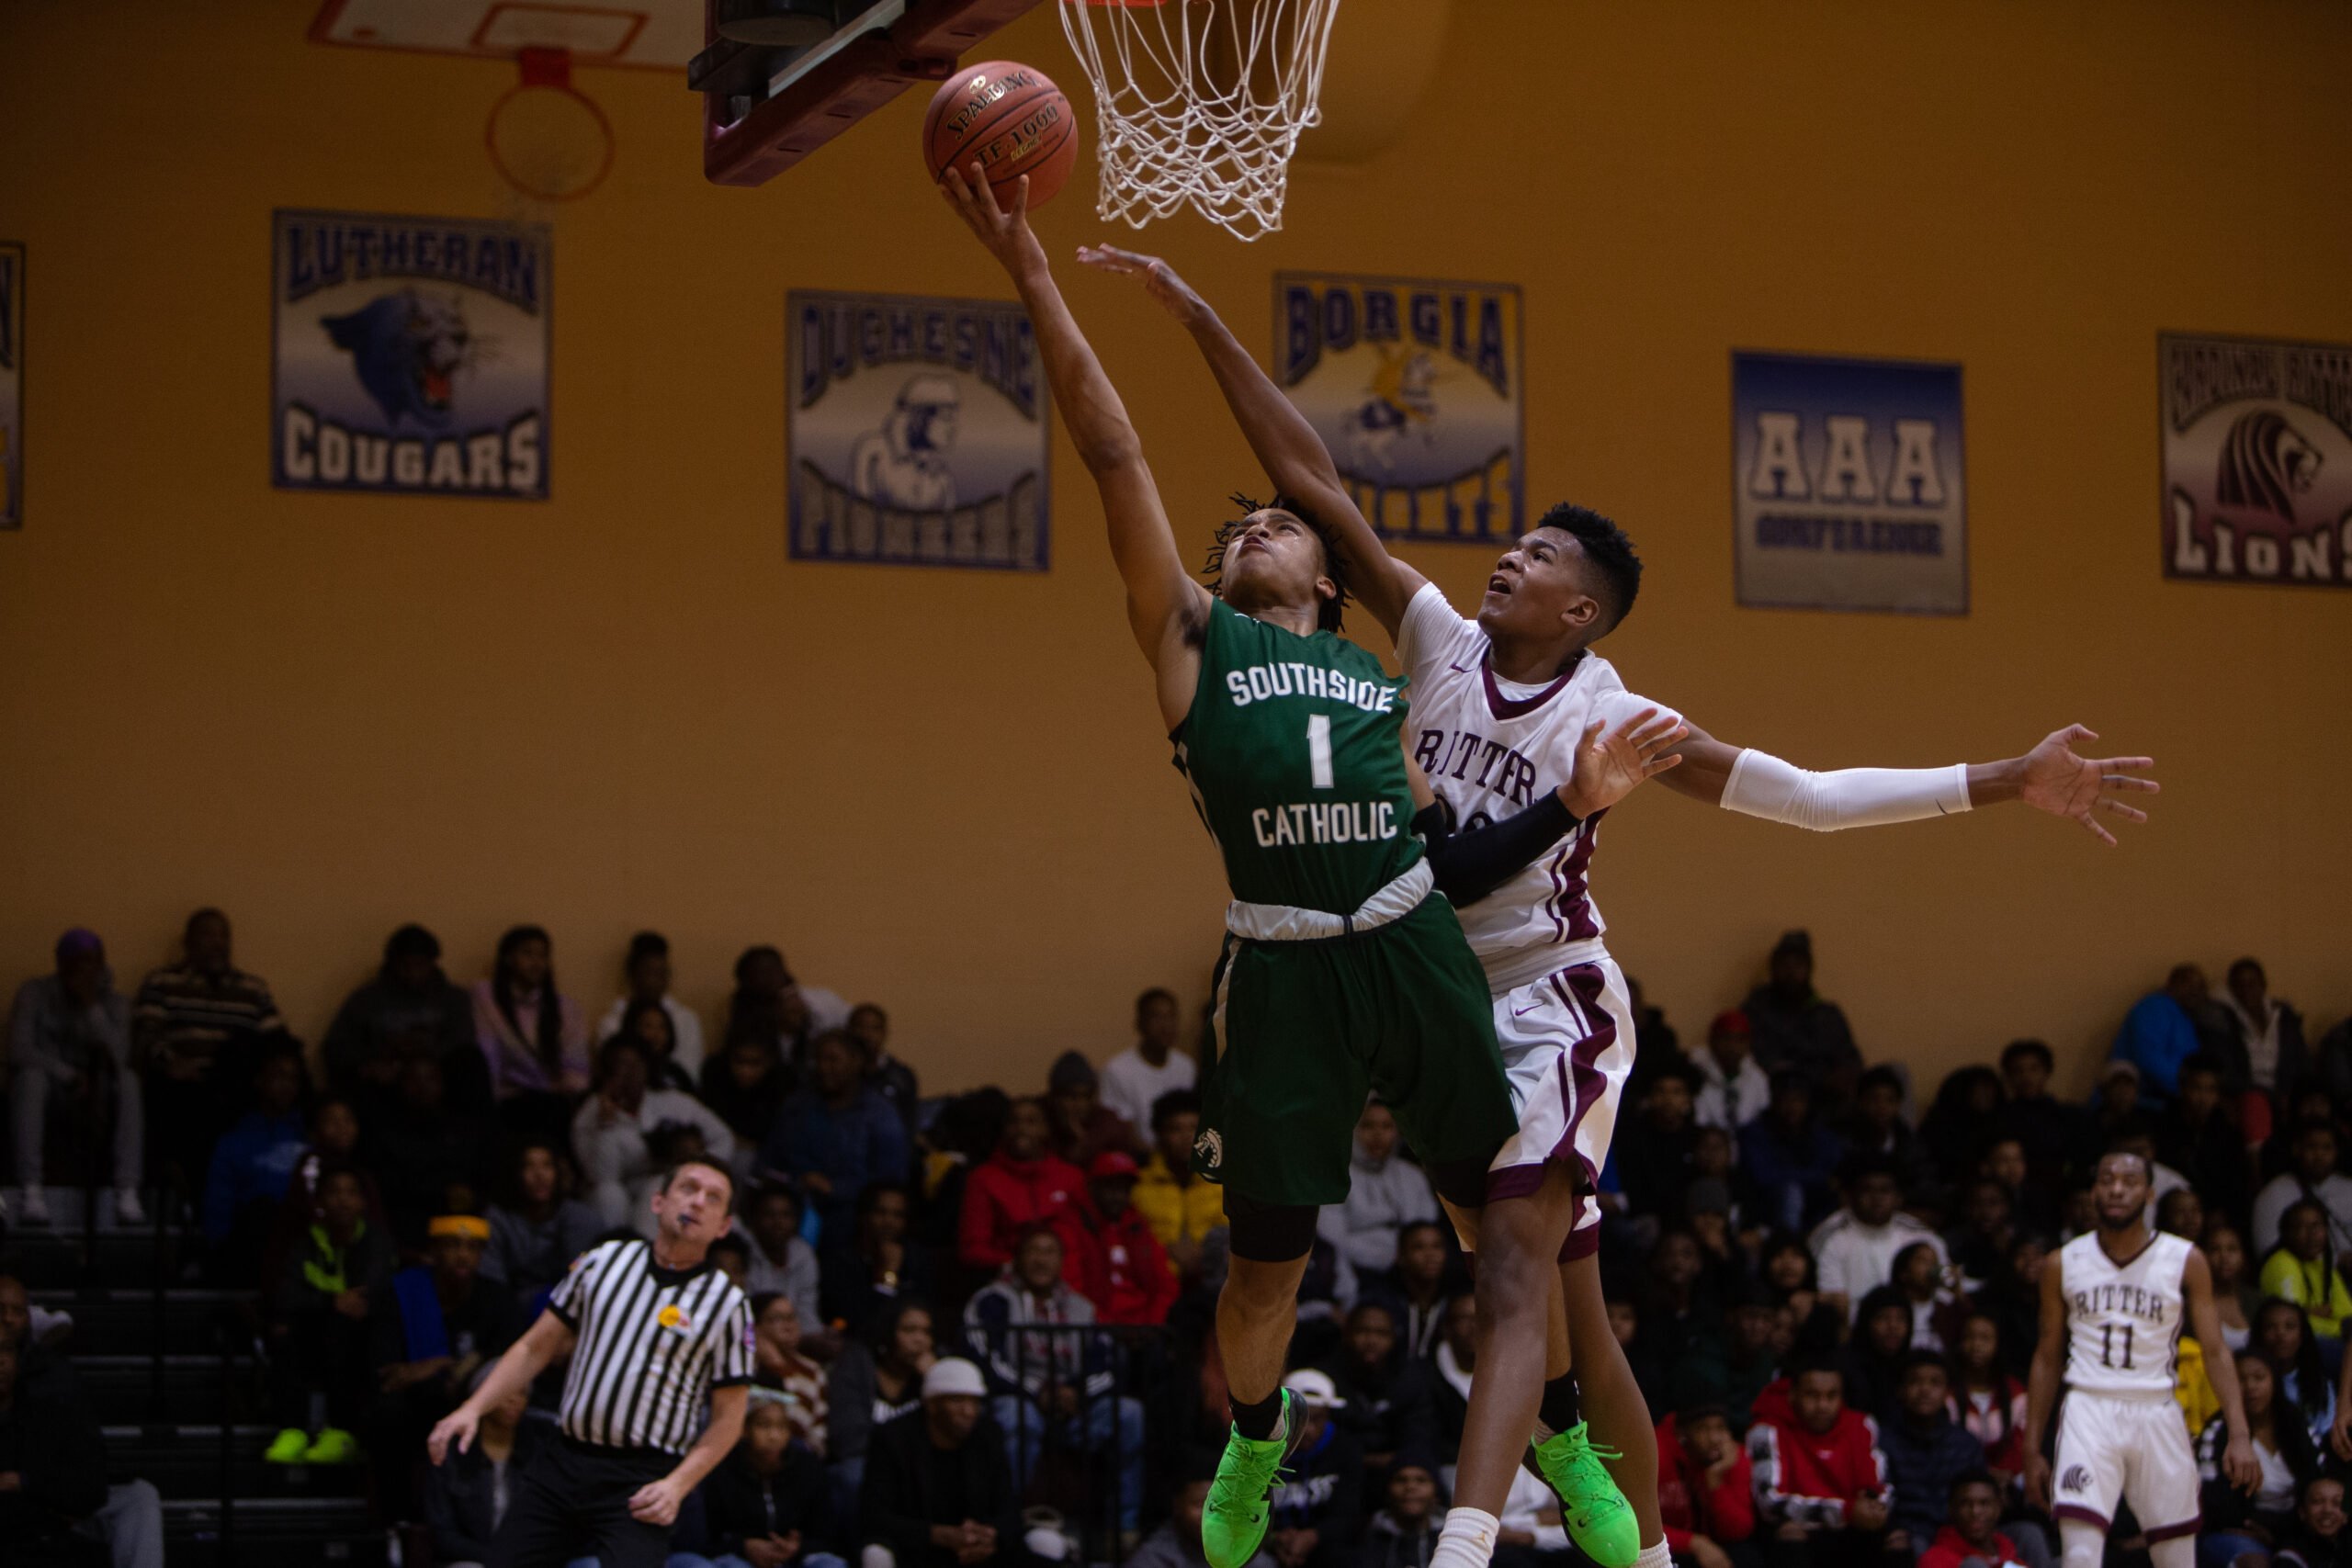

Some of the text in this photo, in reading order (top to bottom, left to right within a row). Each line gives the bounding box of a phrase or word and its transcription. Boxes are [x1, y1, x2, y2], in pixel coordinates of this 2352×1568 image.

[947, 70, 1037, 141] SPALDING
[286, 228, 537, 313] LUTHERAN
[1286, 286, 1508, 400] BORGIA
[284, 402, 540, 489] COUGARS
[1752, 411, 1941, 505] AAA
[1226, 661, 1397, 715] SOUTHSIDE
[1306, 713, 1335, 789] 1
[1251, 801, 1398, 849] CATHOLIC
[2075, 1285, 2164, 1323] RITTER
[2099, 1322, 2136, 1370] 11
